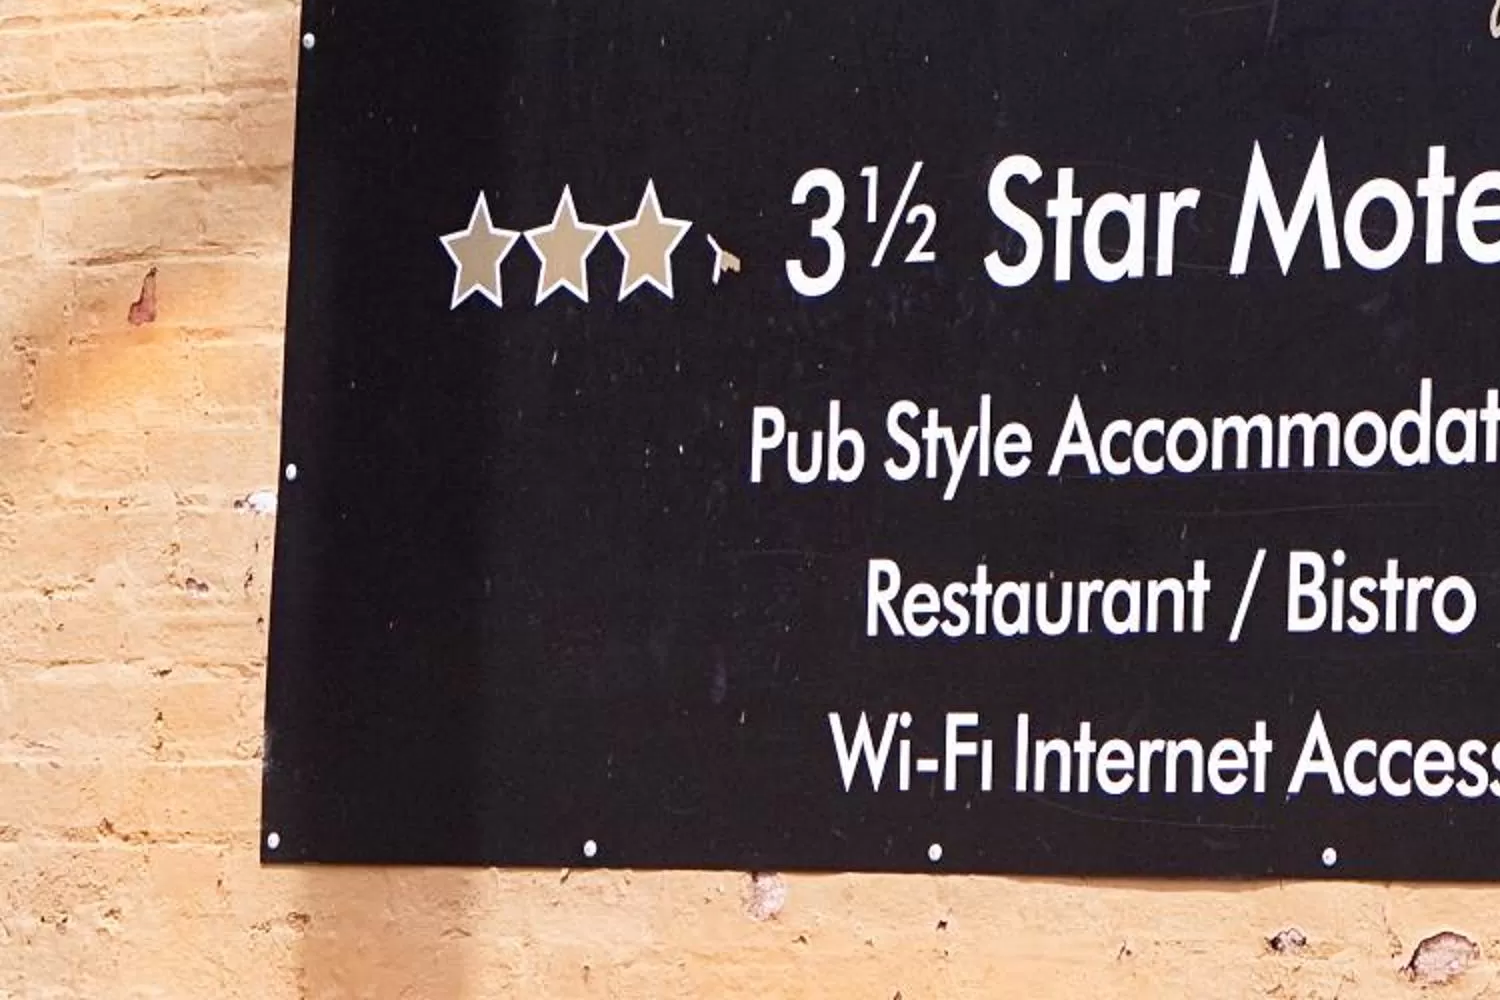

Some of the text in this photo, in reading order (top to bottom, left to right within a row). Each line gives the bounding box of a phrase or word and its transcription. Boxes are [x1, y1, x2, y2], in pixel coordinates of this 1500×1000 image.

[983, 154, 1201, 288] Star
[750, 399, 866, 484] Pub
[883, 393, 1033, 501] Style
[866, 548, 1477, 643] Restaurant / Bistro
[827, 710, 993, 793] Wi-Fi
[1015, 712, 1273, 795] Internet
